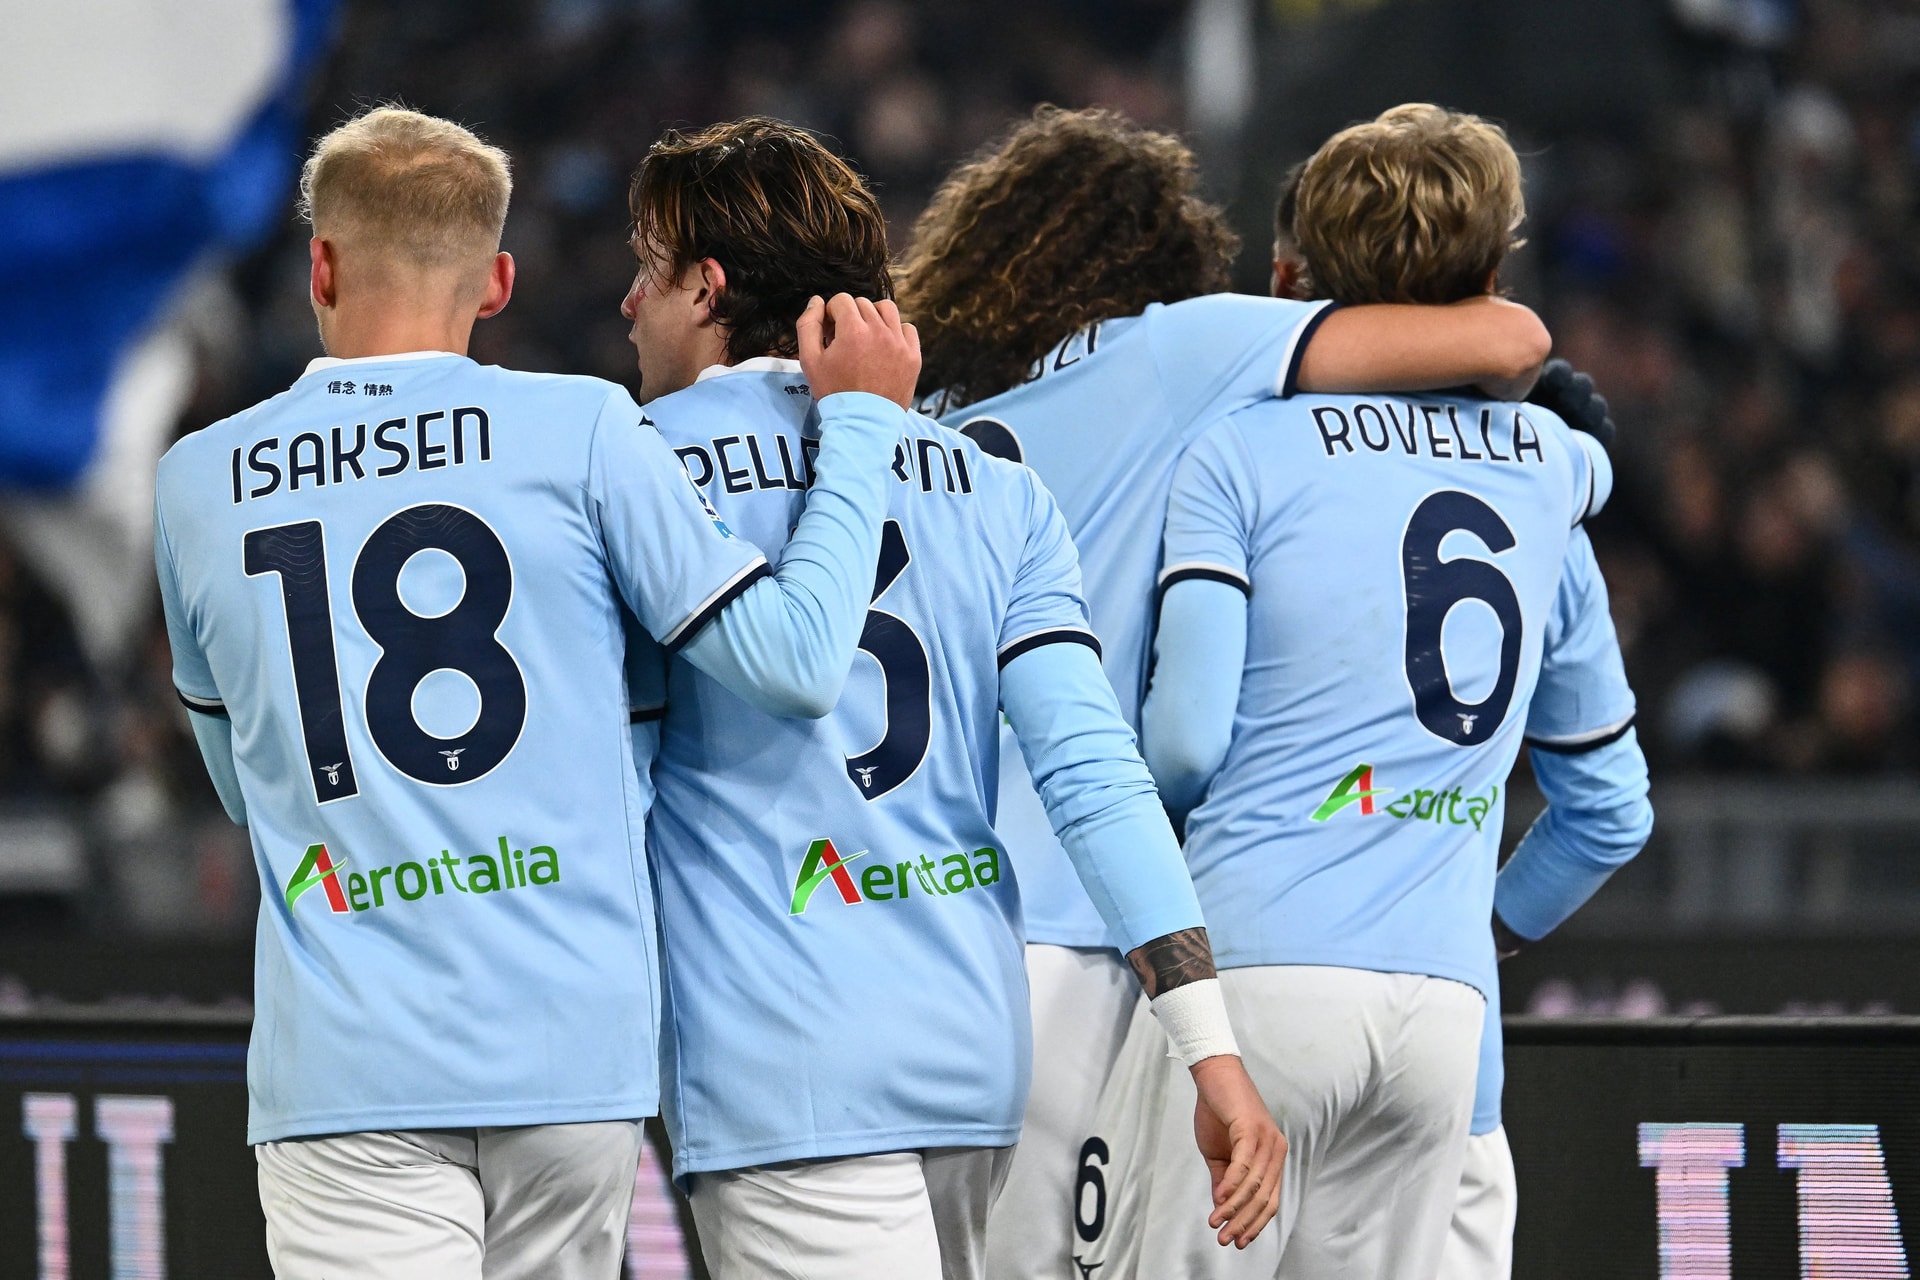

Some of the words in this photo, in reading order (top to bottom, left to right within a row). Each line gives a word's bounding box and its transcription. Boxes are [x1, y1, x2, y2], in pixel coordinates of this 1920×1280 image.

[327, 380, 357, 395] 信念
[363, 382, 394, 397] 情熱
[1310, 401, 1545, 465] ROVELLA
[231, 406, 492, 505] ISAKSEN
[673, 432, 973, 496] PELLRNI
[243, 501, 528, 807] 18
[1400, 487, 1524, 749] 6
[285, 835, 561, 917] Aeroitalia
[1074, 1136, 1110, 1243] 6
